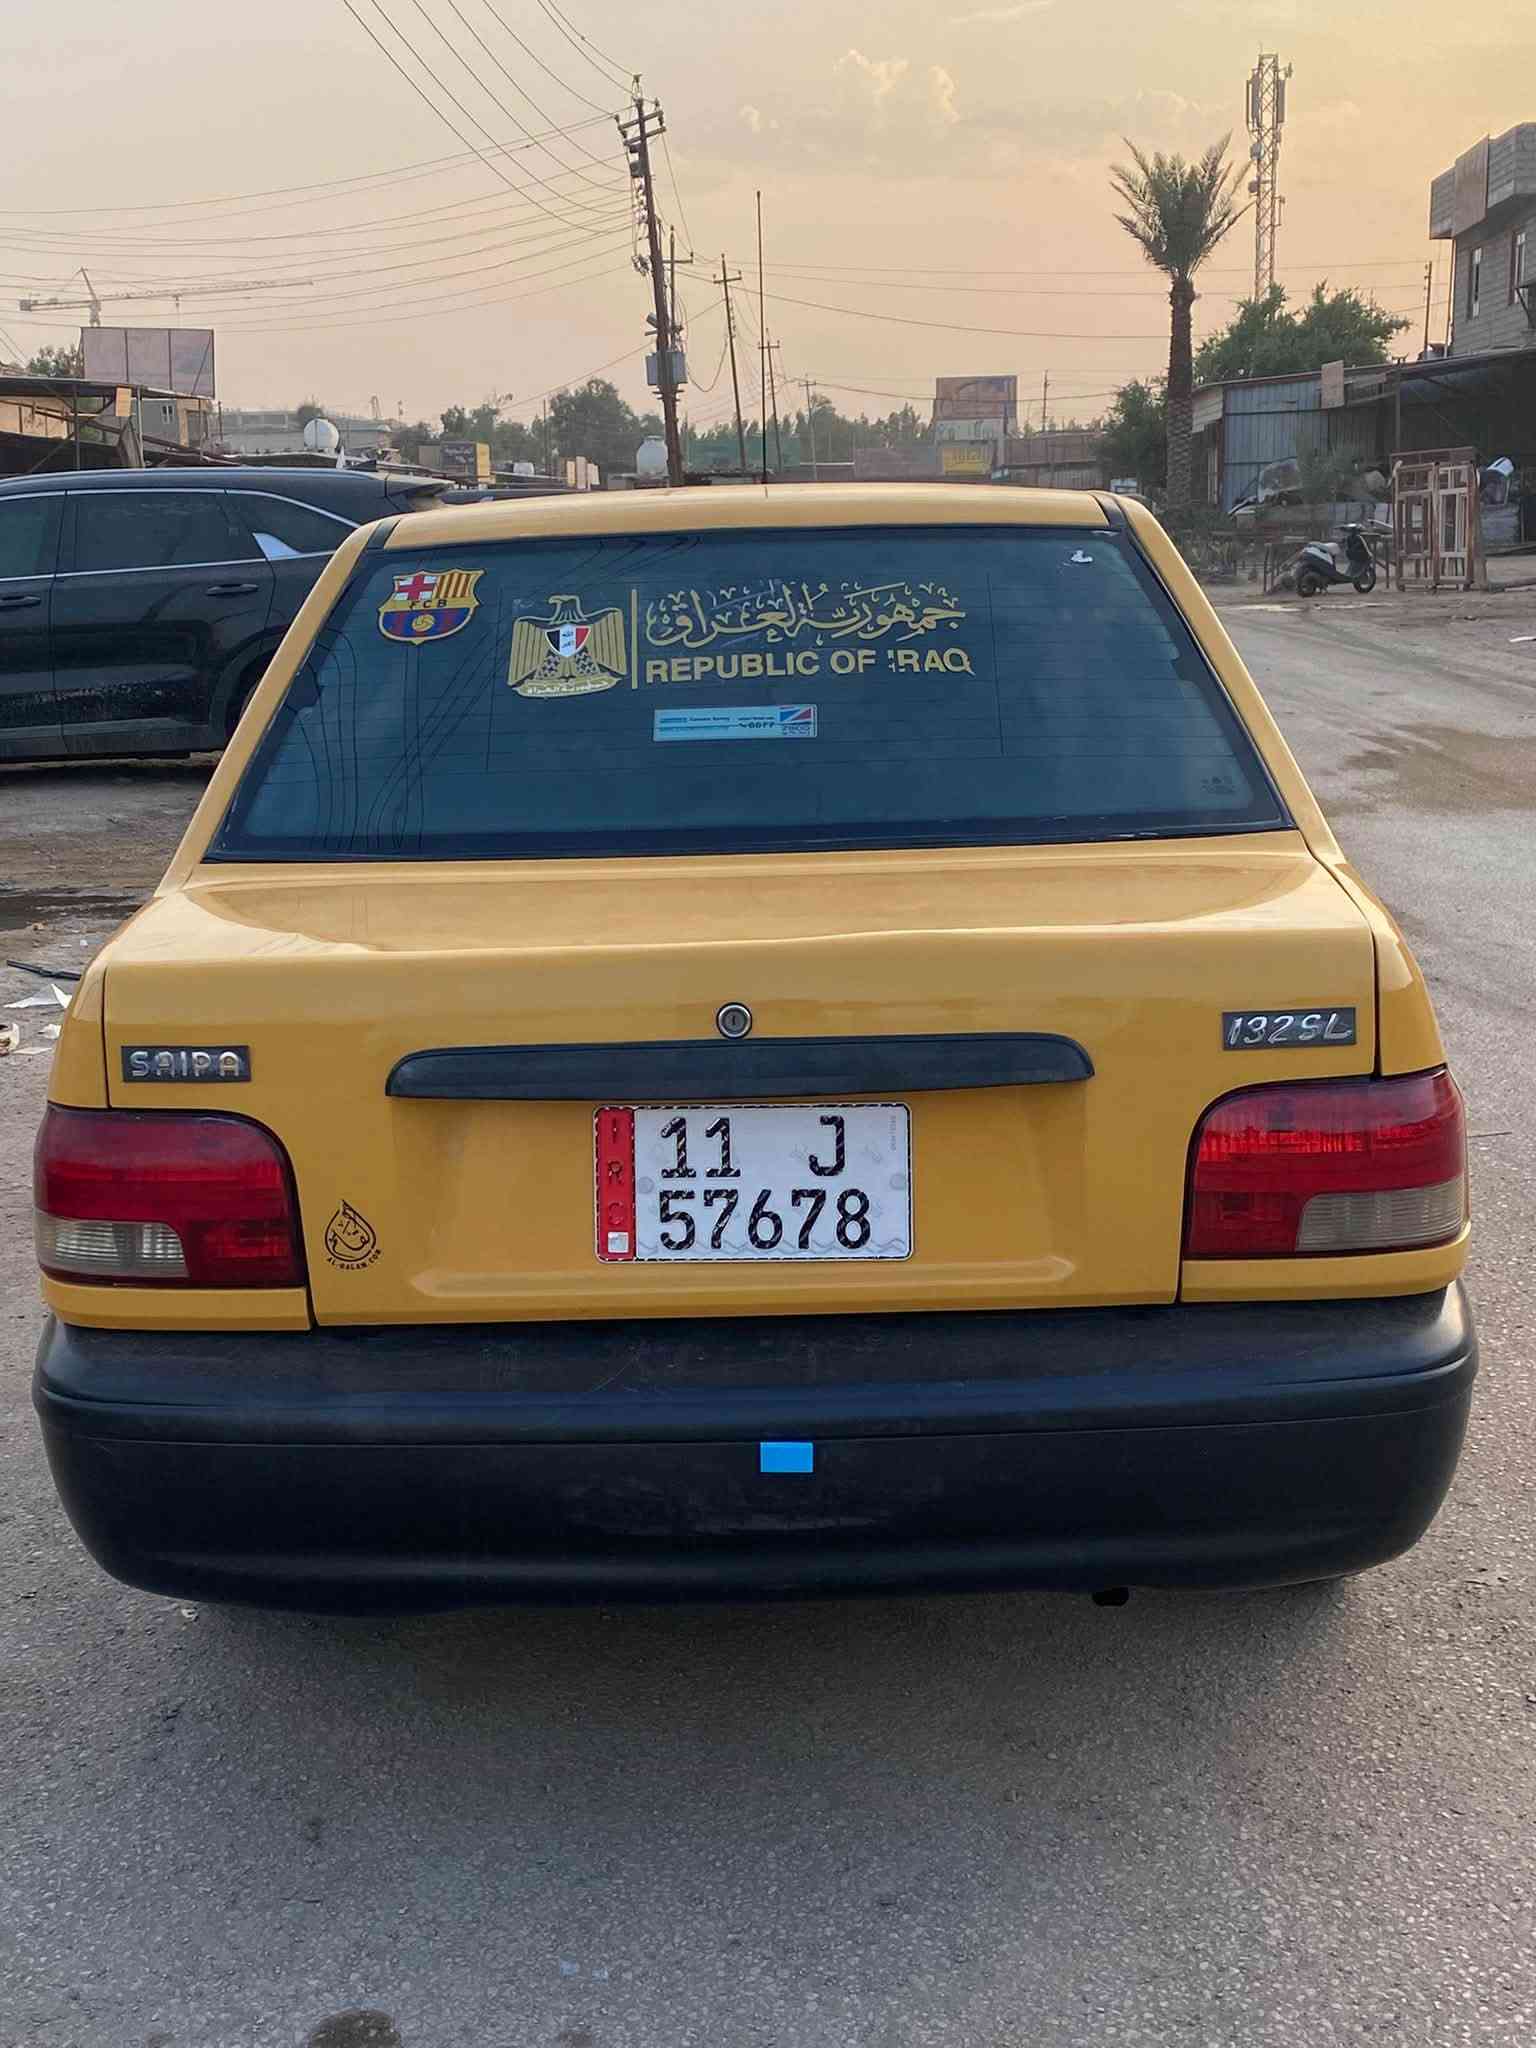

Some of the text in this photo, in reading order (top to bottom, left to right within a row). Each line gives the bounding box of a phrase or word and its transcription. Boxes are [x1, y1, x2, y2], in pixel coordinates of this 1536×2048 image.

[408, 598, 448, 610] FCB
[646, 647, 976, 683] REPUBLIC OF IRAQ
[130, 1050, 240, 1078] SAIPA
[661, 1116, 742, 1178] 11
[808, 1115, 846, 1177] J
[659, 1188, 871, 1250] 57678
